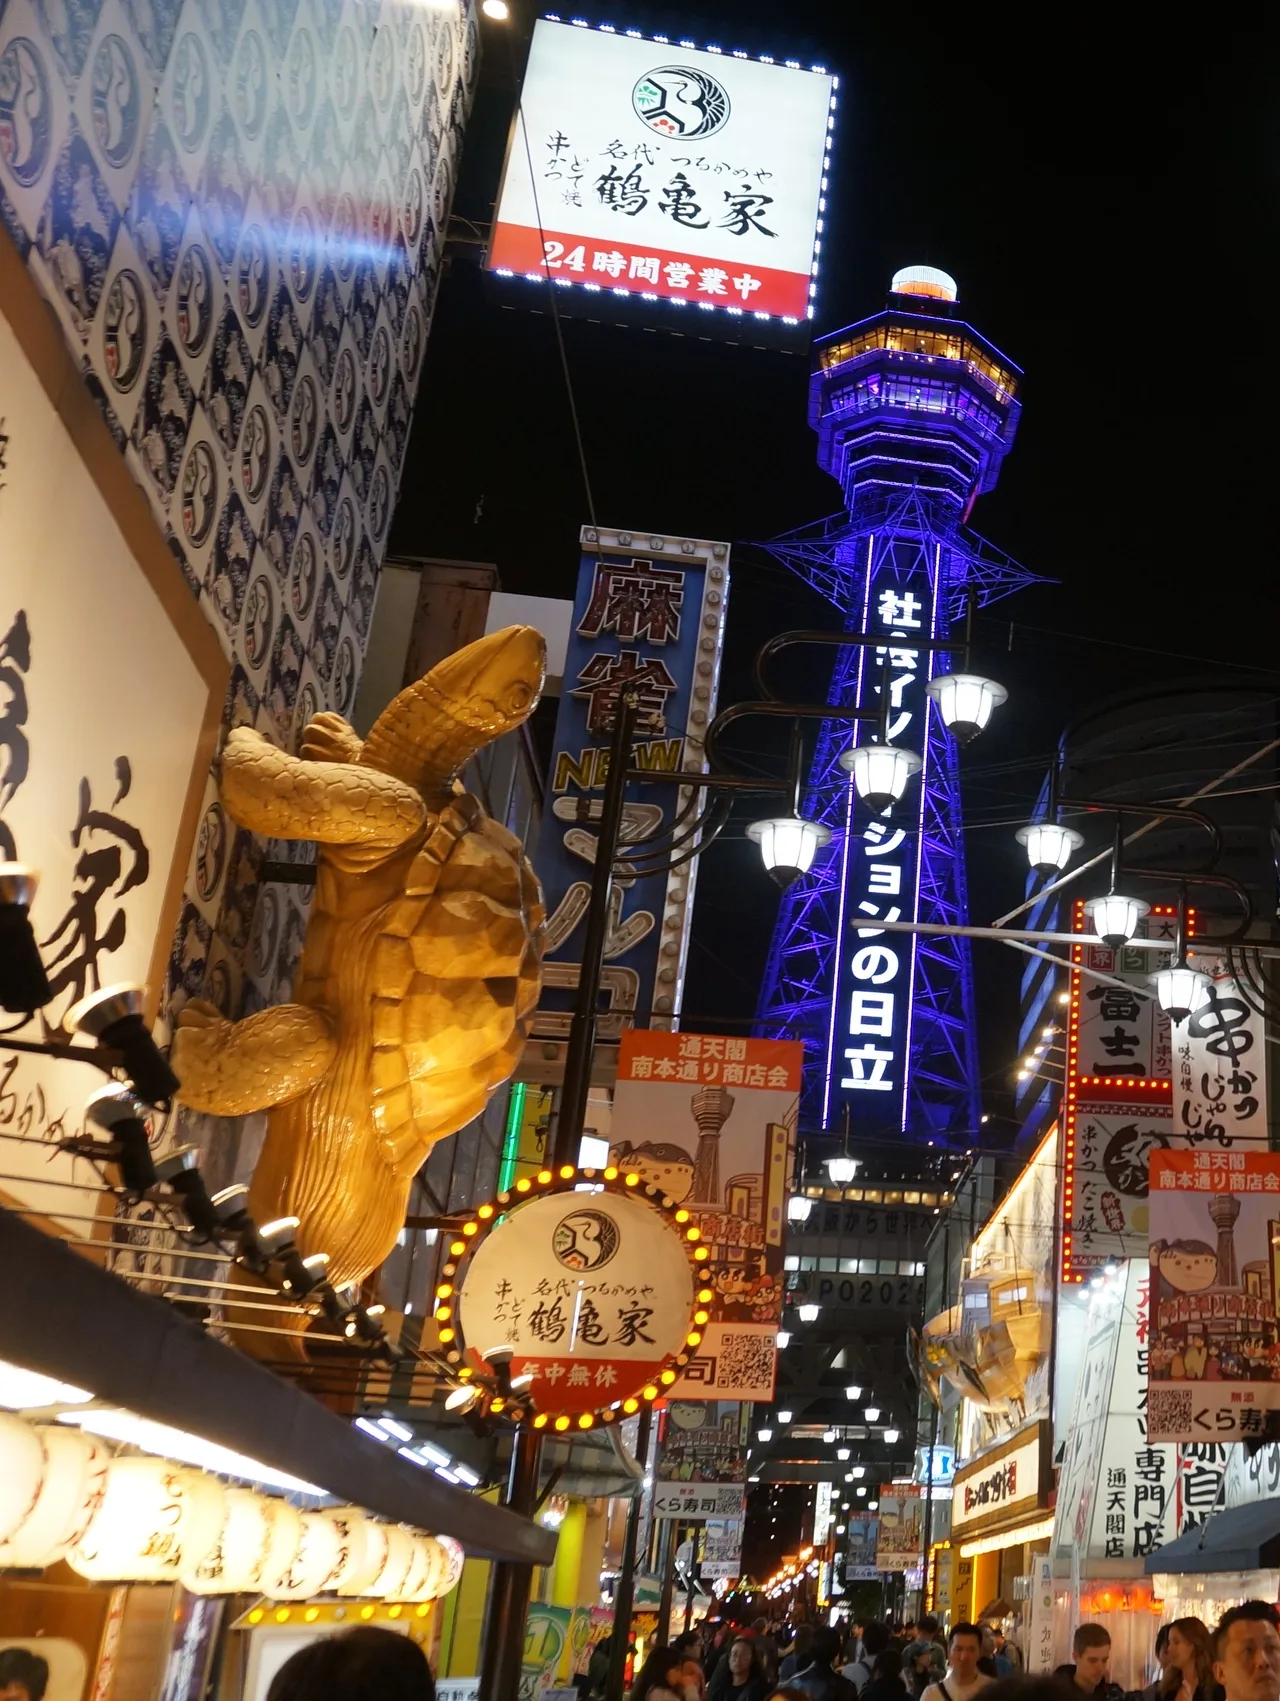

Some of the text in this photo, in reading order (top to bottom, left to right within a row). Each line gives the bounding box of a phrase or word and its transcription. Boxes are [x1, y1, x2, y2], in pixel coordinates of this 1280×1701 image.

[592, 163, 780, 239] 鶴亀家
[539, 240, 763, 300] 24時間営業中
[566, 558, 685, 738] 麻雀
[841, 587, 923, 1091] 社会イノションの日立
[630, 1055, 790, 1088] 南本通り商店会
[678, 1035, 748, 1061] 通天閣
[1177, 1042, 1196, 1094] 味自慢
[1187, 985, 1259, 1121] 串かつ
[1081, 1124, 1099, 1172] 串かつ
[1193, 1151, 1245, 1171] 通天閣
[1159, 1169, 1280, 1191] 南本通り商店会
[1075, 1180, 1099, 1249] たこ焼き
[527, 1297, 657, 1347] 鶴亀家
[520, 1361, 619, 1388] 年中無休
[1193, 1407, 1272, 1433] くら寿
[654, 1497, 717, 1514] くら寿司
[1104, 1466, 1128, 1558] 通天閣店
